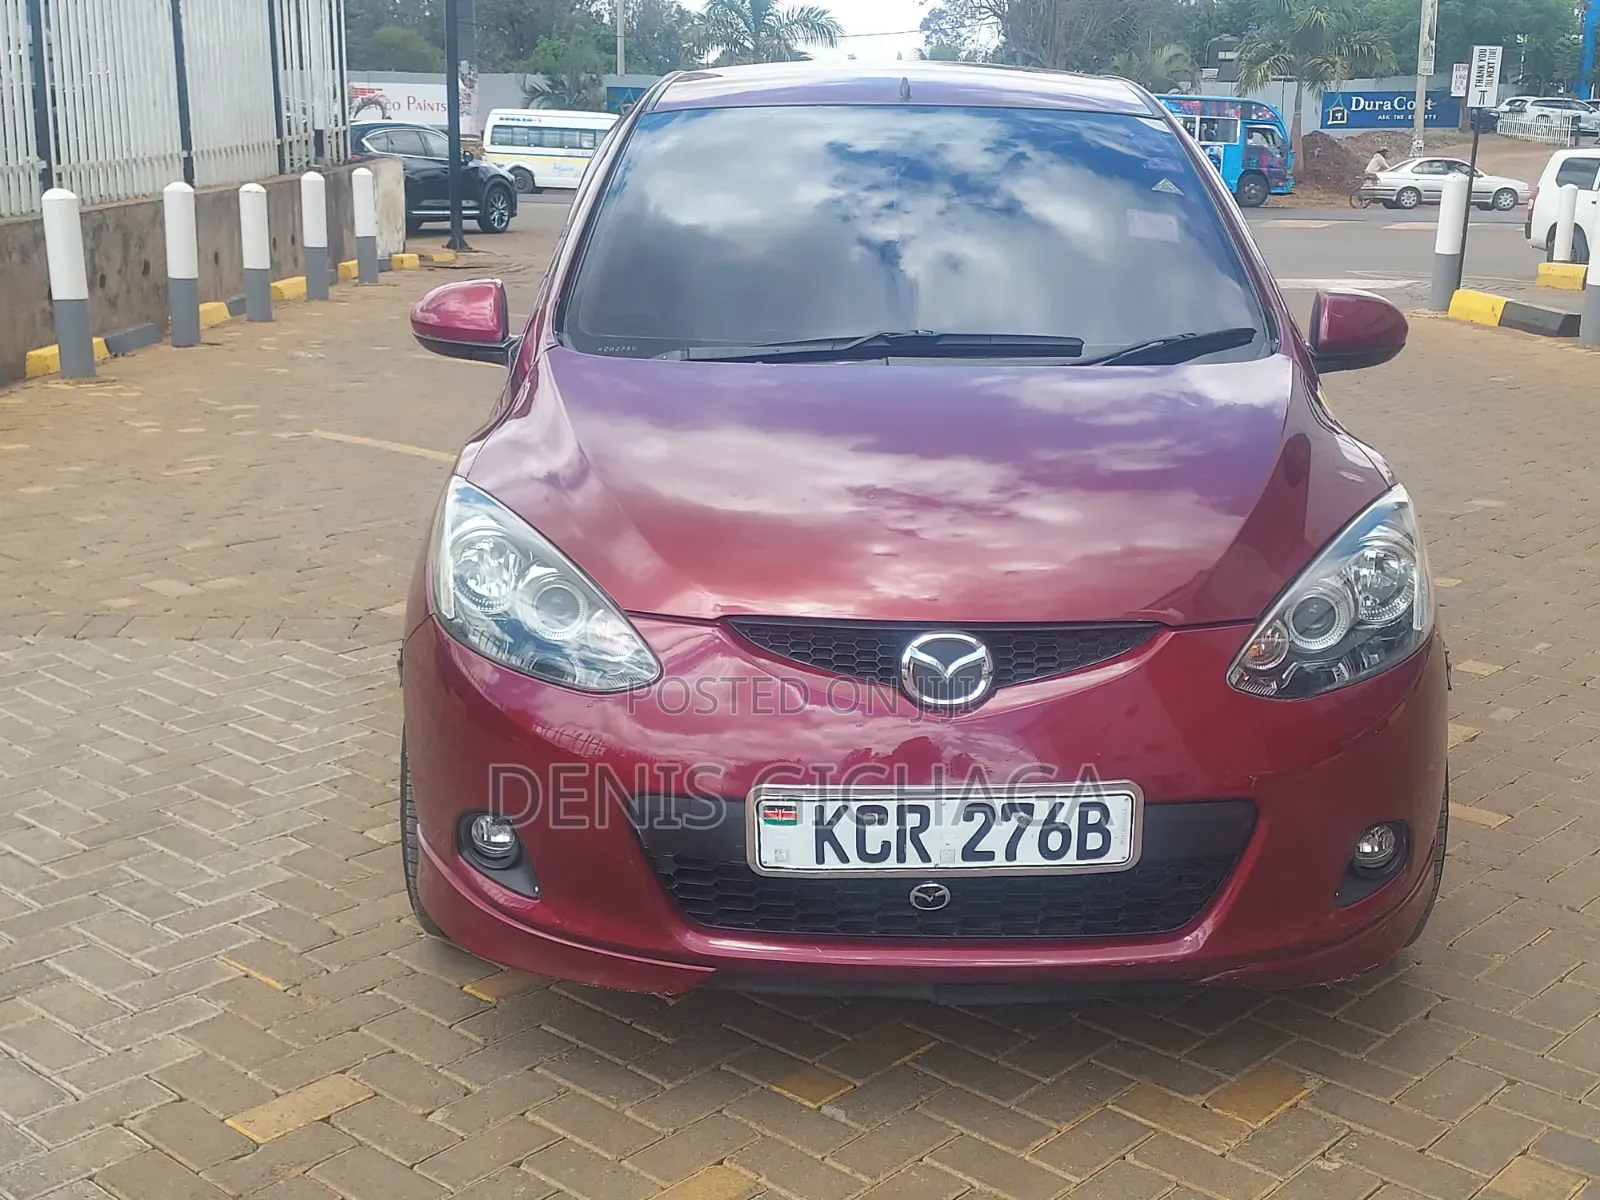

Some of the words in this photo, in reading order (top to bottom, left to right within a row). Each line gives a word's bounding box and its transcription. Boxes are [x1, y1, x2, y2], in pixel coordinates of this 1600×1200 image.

[1478, 48, 1487, 63] YOU
[1474, 65, 1486, 88] THANK
[1486, 62, 1496, 78] NEXT
[1351, 96, 1435, 111] DuraCot
[815, 804, 932, 866] KCR
[960, 801, 1112, 862] 276B
